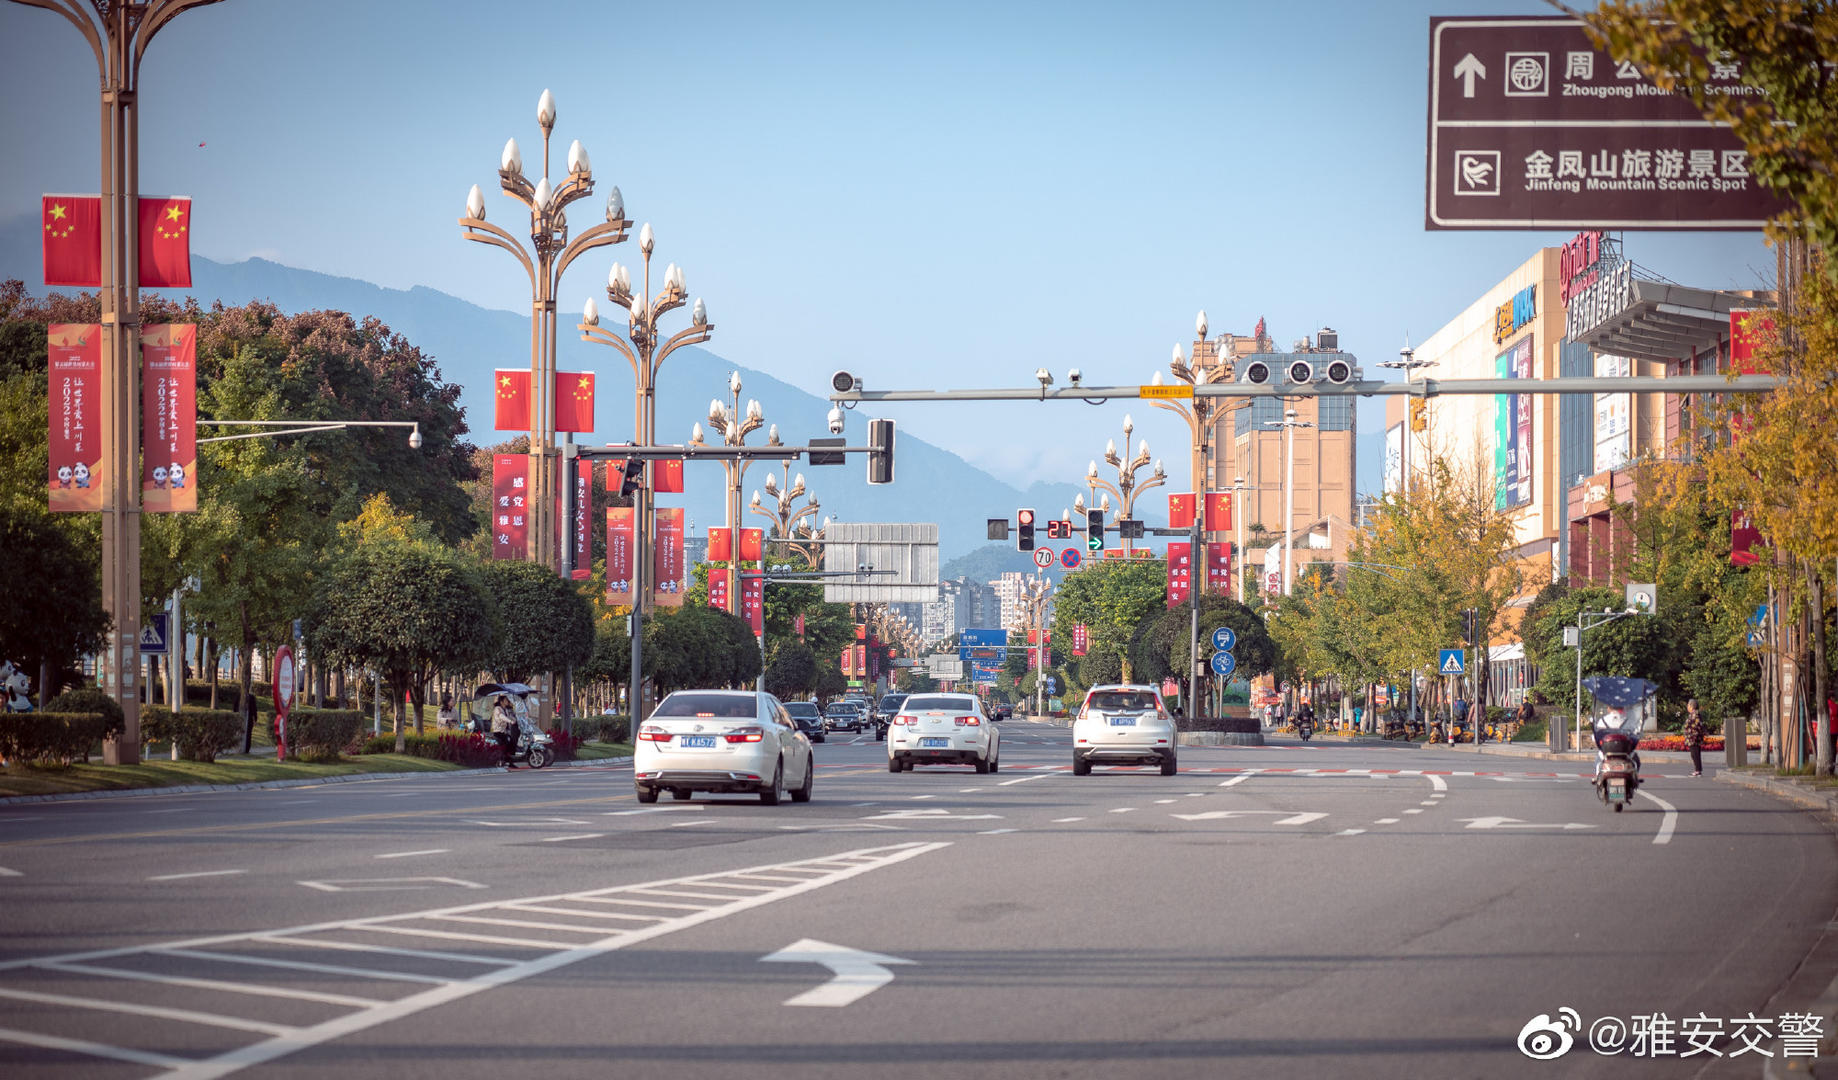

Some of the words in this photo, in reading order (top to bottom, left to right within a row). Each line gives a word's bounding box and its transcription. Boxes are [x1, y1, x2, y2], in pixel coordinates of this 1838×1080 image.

[1562, 83, 1633, 99] Zhougong
[1525, 149, 1749, 179] 金凤山旅游景区
[1525, 178, 1581, 193] Jinfeng
[1586, 177, 1656, 191] Mountain
[1658, 178, 1710, 191] Scenic
[1712, 178, 1747, 192] Spot
[513, 477, 524, 526] 感党恩
[499, 495, 509, 545] 爱雅安
[1049, 521, 1071, 538] 27
[1038, 551, 1051, 563] 70
